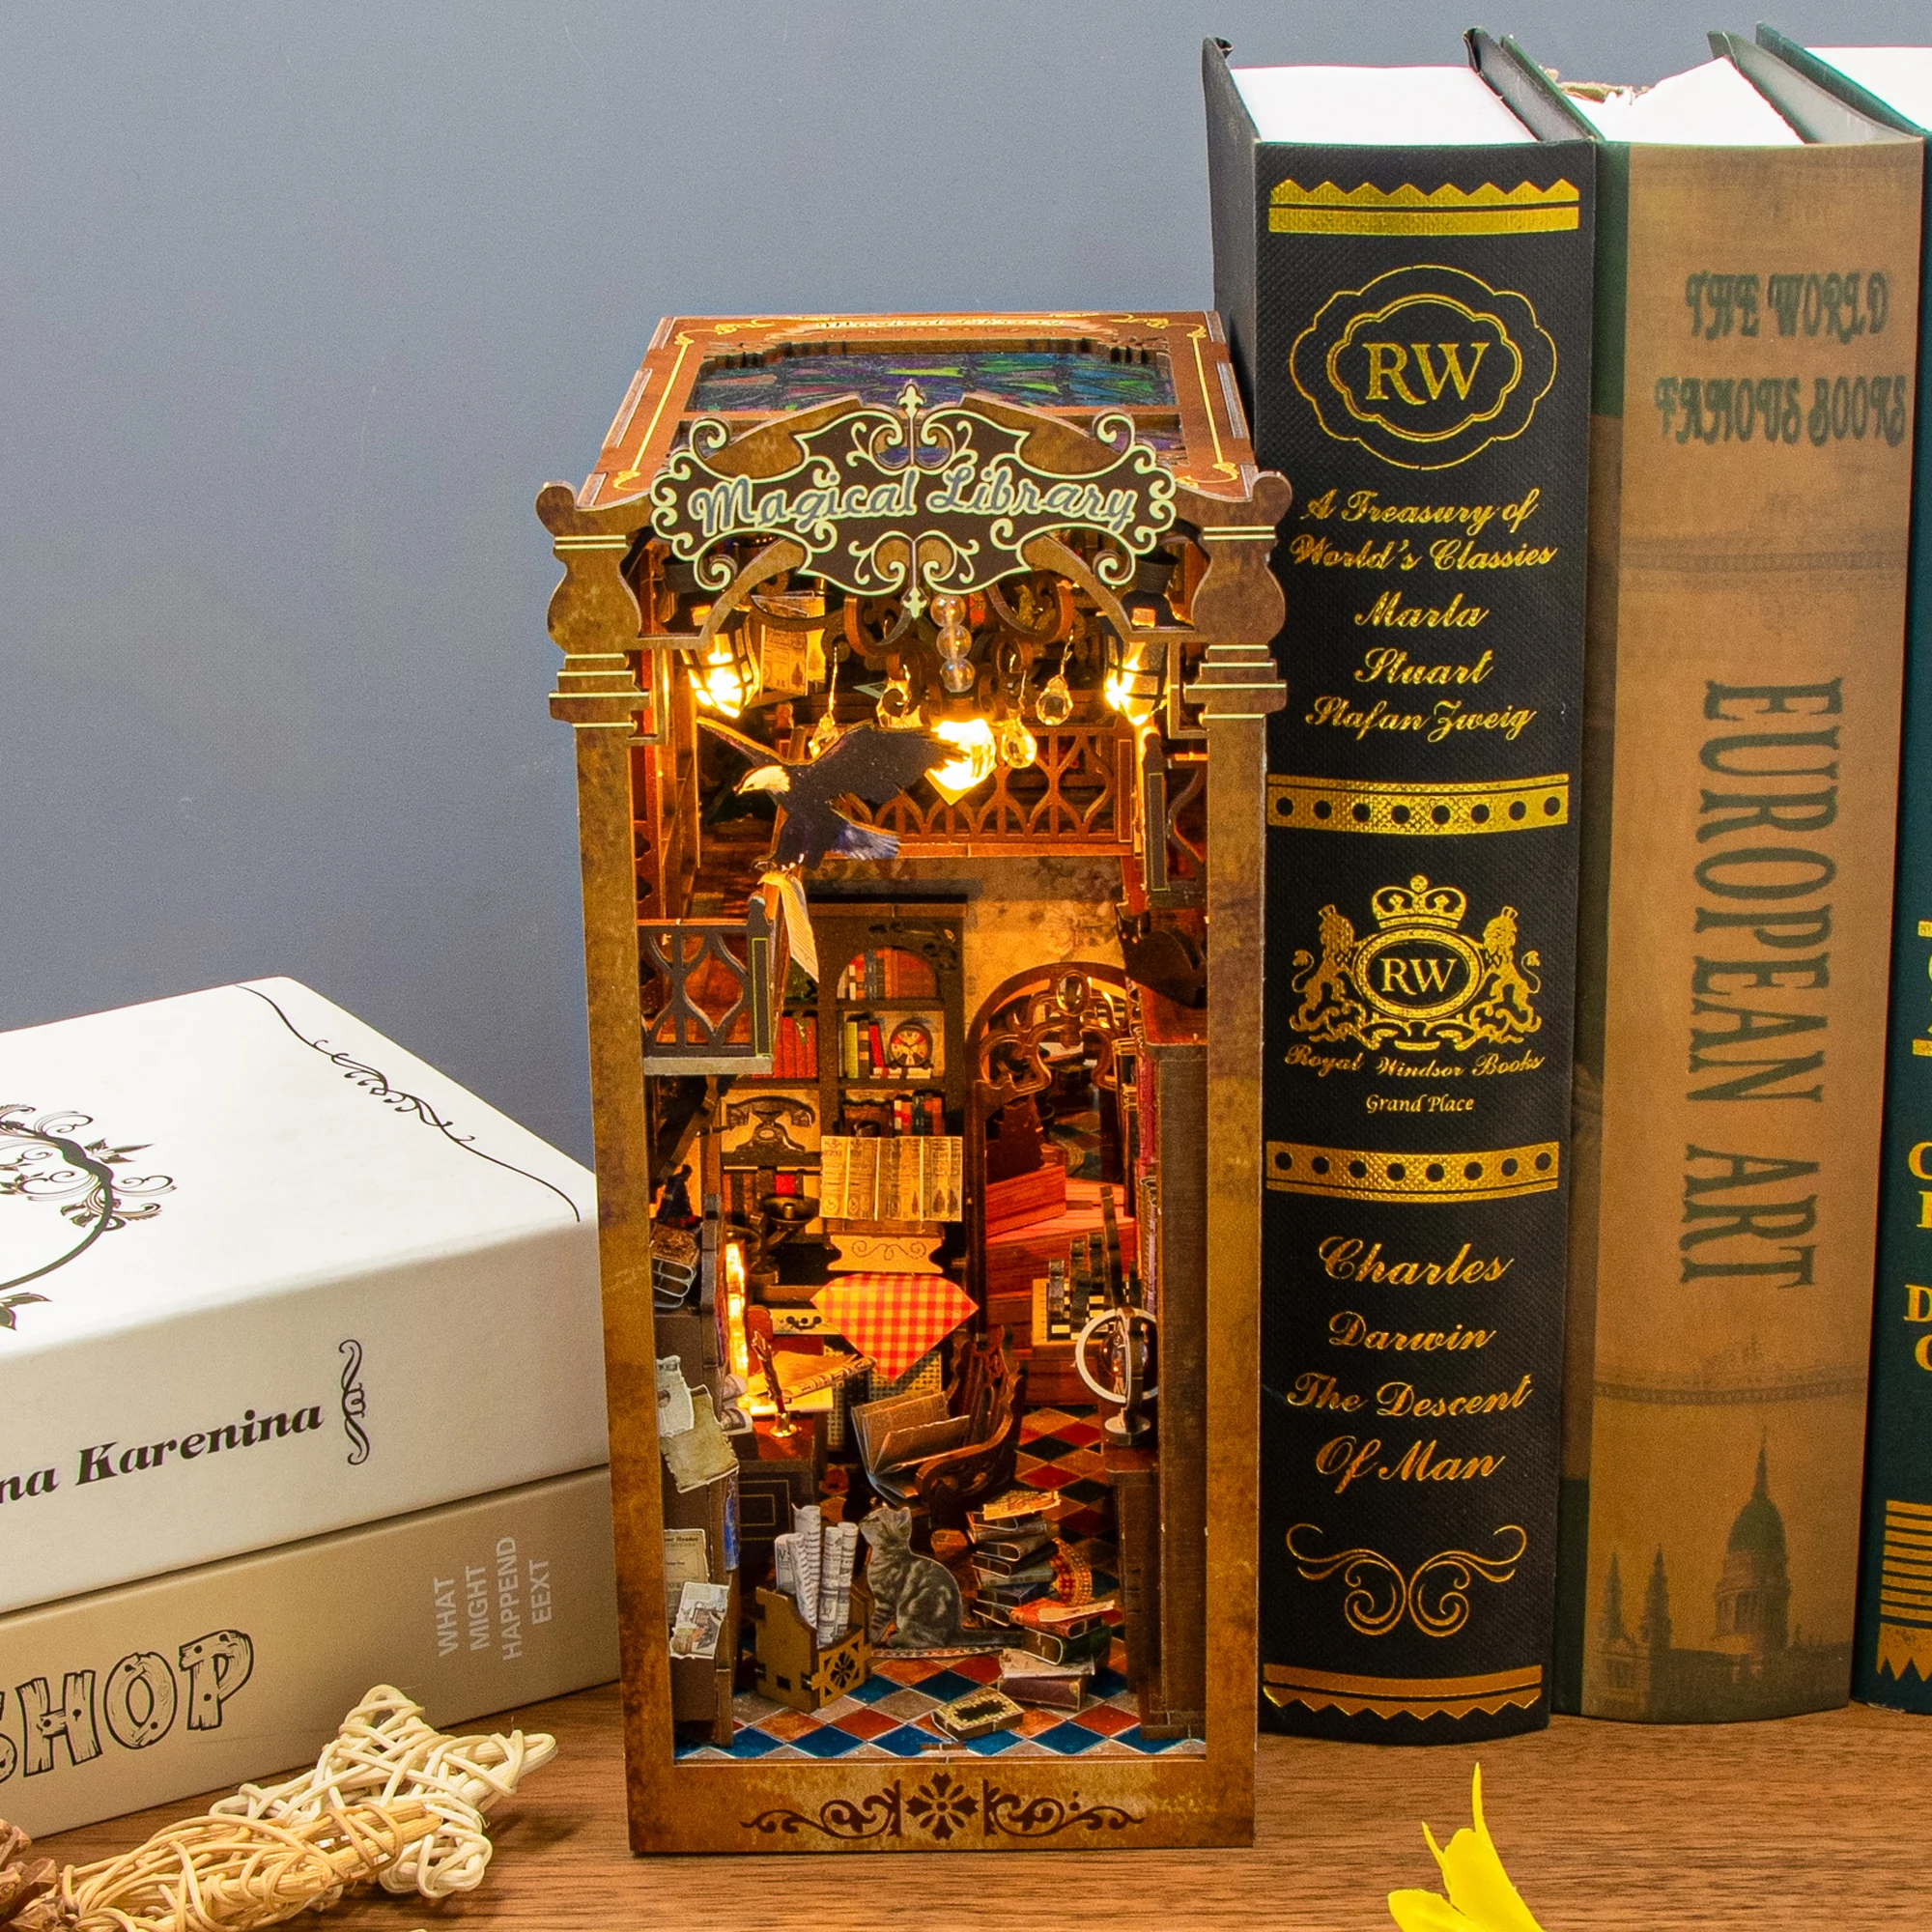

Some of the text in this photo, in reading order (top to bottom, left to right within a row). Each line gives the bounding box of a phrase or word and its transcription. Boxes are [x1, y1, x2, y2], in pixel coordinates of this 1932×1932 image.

[1363, 342, 1490, 405] RW
[689, 465, 1138, 537] Magical Library
[1300, 487, 1542, 536] A Treasury of
[1290, 534, 1424, 571] World's
[1354, 590, 1490, 629] Marla
[1353, 647, 1494, 685] Stuart
[1427, 699, 1538, 743] Zweig
[1380, 957, 1458, 996] RW
[1678, 676, 1844, 1290] EUROPEAN ART
[1285, 1044, 1546, 1078] Royal Windsor Books
[1366, 1094, 1475, 1114] Grand Place
[1319, 1236, 1515, 1286] Charles
[1328, 1311, 1496, 1351] Darwin
[1287, 1372, 1534, 1418] The Descent
[74, 1406, 325, 1486] Karenina
[1316, 1435, 1506, 1494] Of Man
[466, 1566, 491, 1652] MIGHT
[496, 1536, 523, 1661] HAPPEND
[529, 1558, 553, 1625] EEXT
[433, 1577, 459, 1658] WHAT
[0, 1629, 255, 1783] HOP
